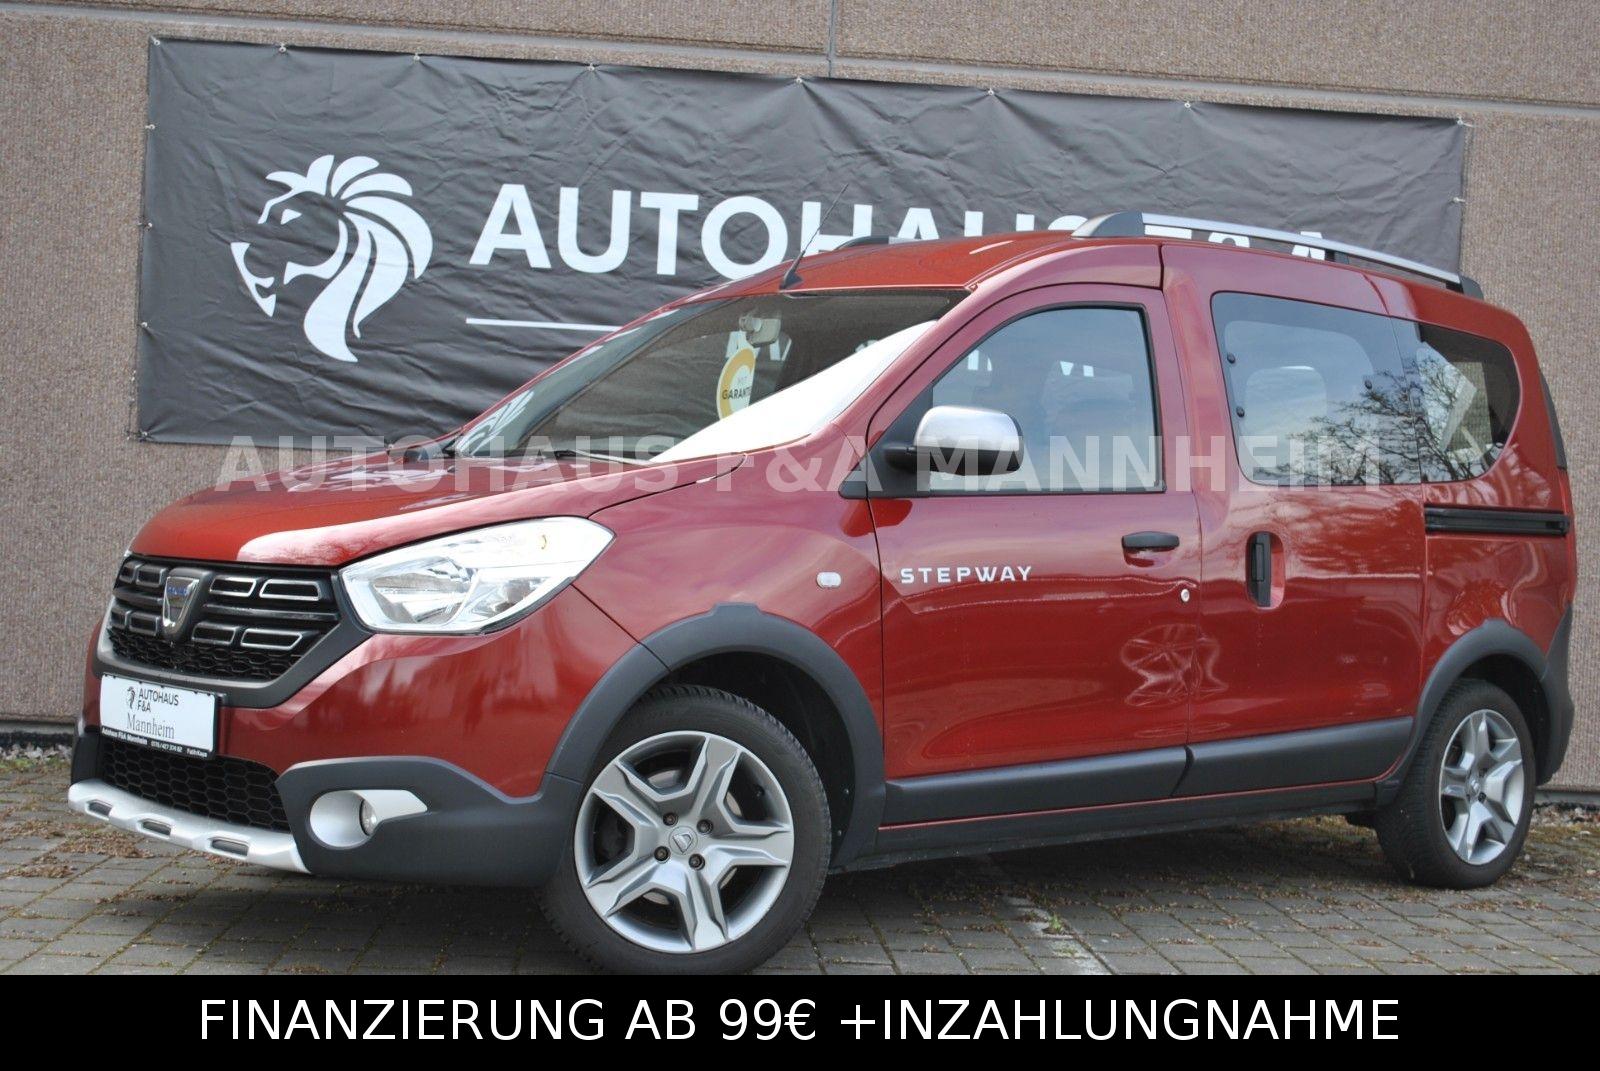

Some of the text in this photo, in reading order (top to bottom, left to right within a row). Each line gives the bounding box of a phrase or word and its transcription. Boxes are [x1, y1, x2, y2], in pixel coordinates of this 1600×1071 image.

[469, 184, 1088, 280] AUTOH
[900, 566, 1032, 583] STEPWAY
[139, 689, 179, 706] AUTOHAUS
[137, 701, 151, 712] F&A
[127, 713, 175, 739] Mannheim
